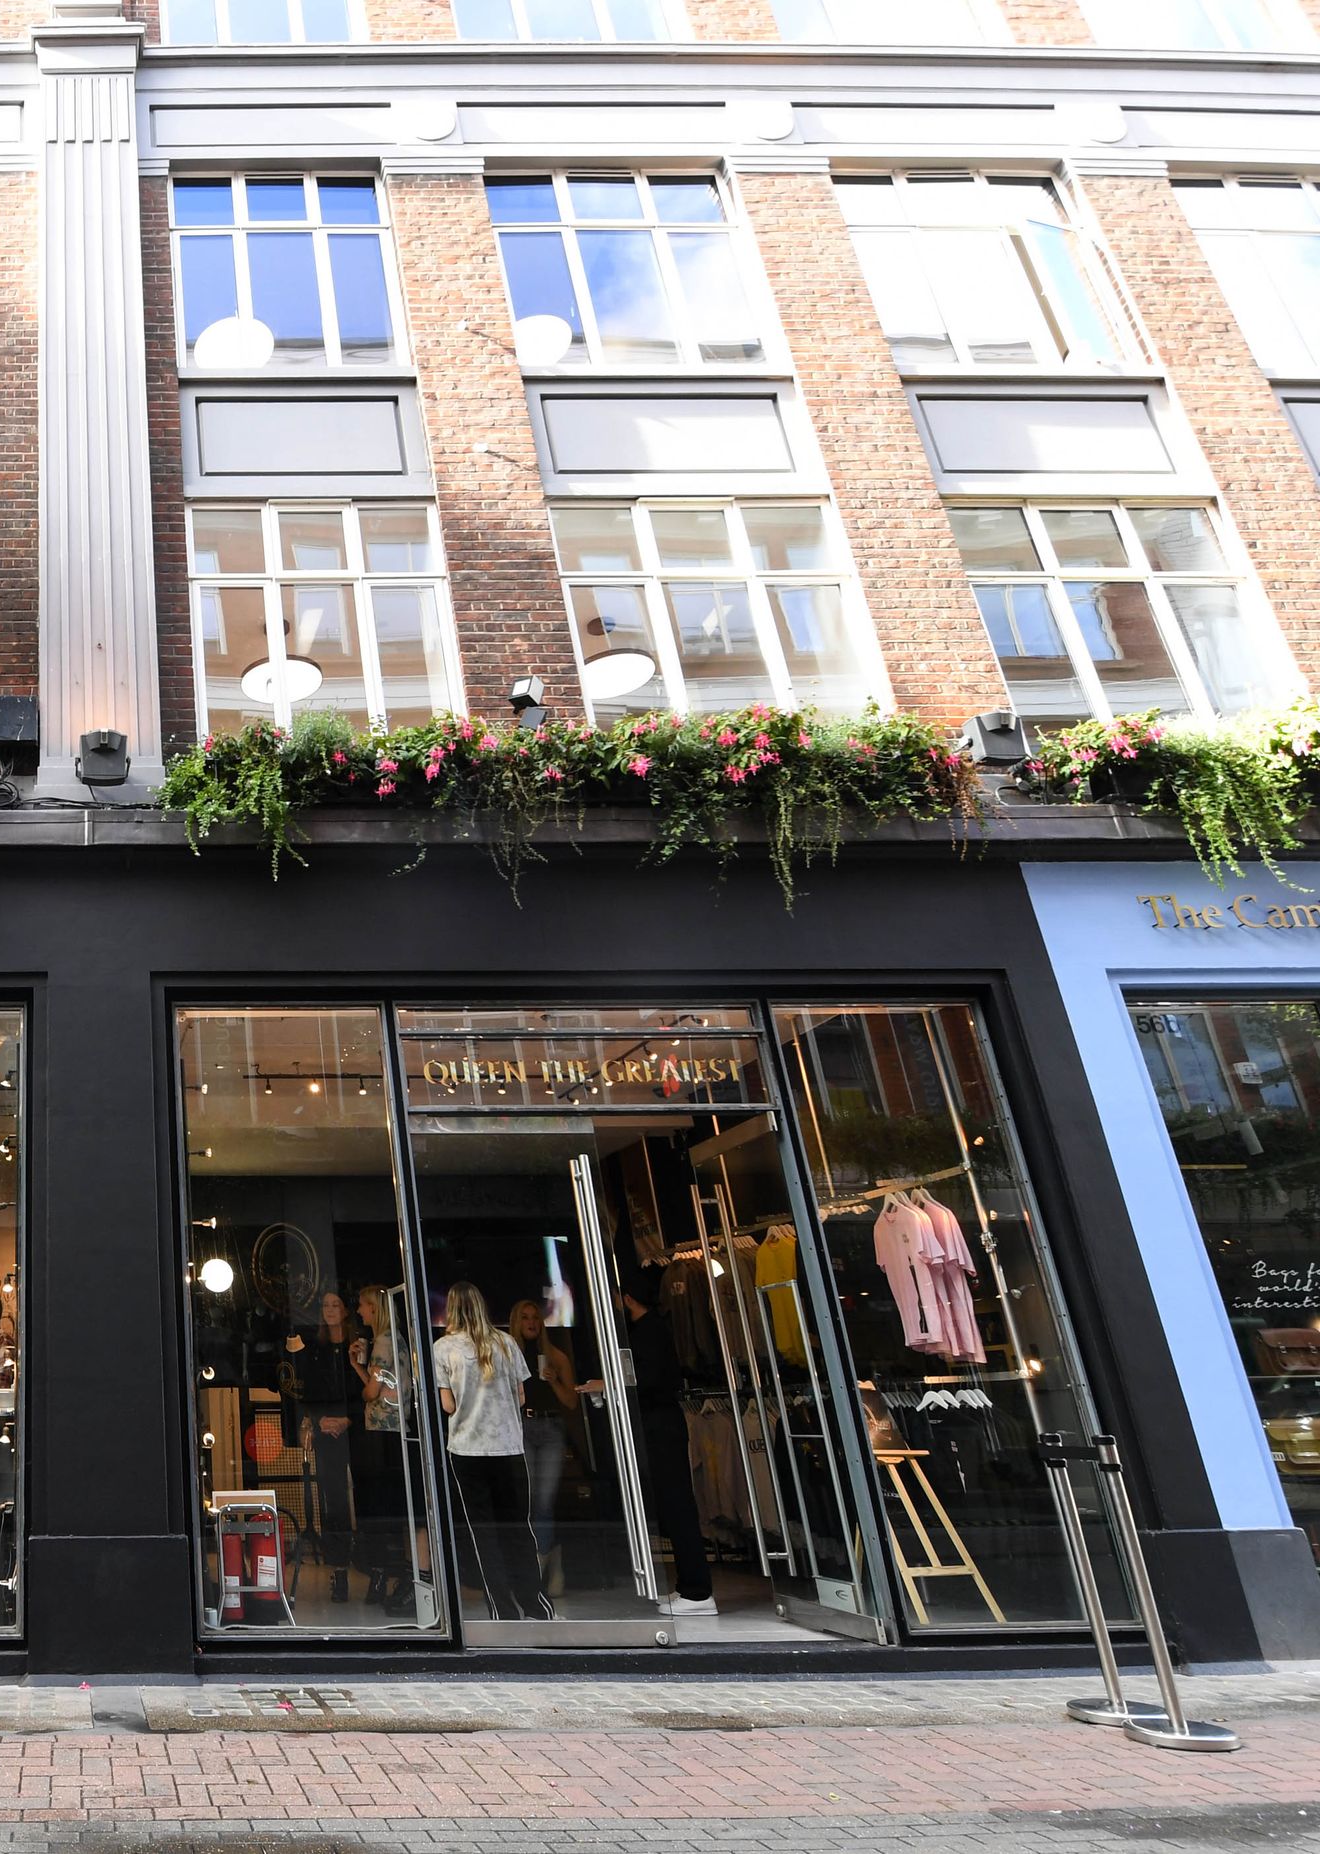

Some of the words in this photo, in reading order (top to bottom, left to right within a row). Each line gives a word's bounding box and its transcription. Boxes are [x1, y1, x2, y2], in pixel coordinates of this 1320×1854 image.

[1136, 892, 1225, 929] The
[1136, 1014, 1180, 1034] 56b
[424, 1059, 527, 1087] QUEEN
[535, 1058, 594, 1084] THE
[601, 1058, 742, 1084] GREATEST
[1251, 1260, 1299, 1283] Bags
[1257, 1279, 1320, 1292] world'
